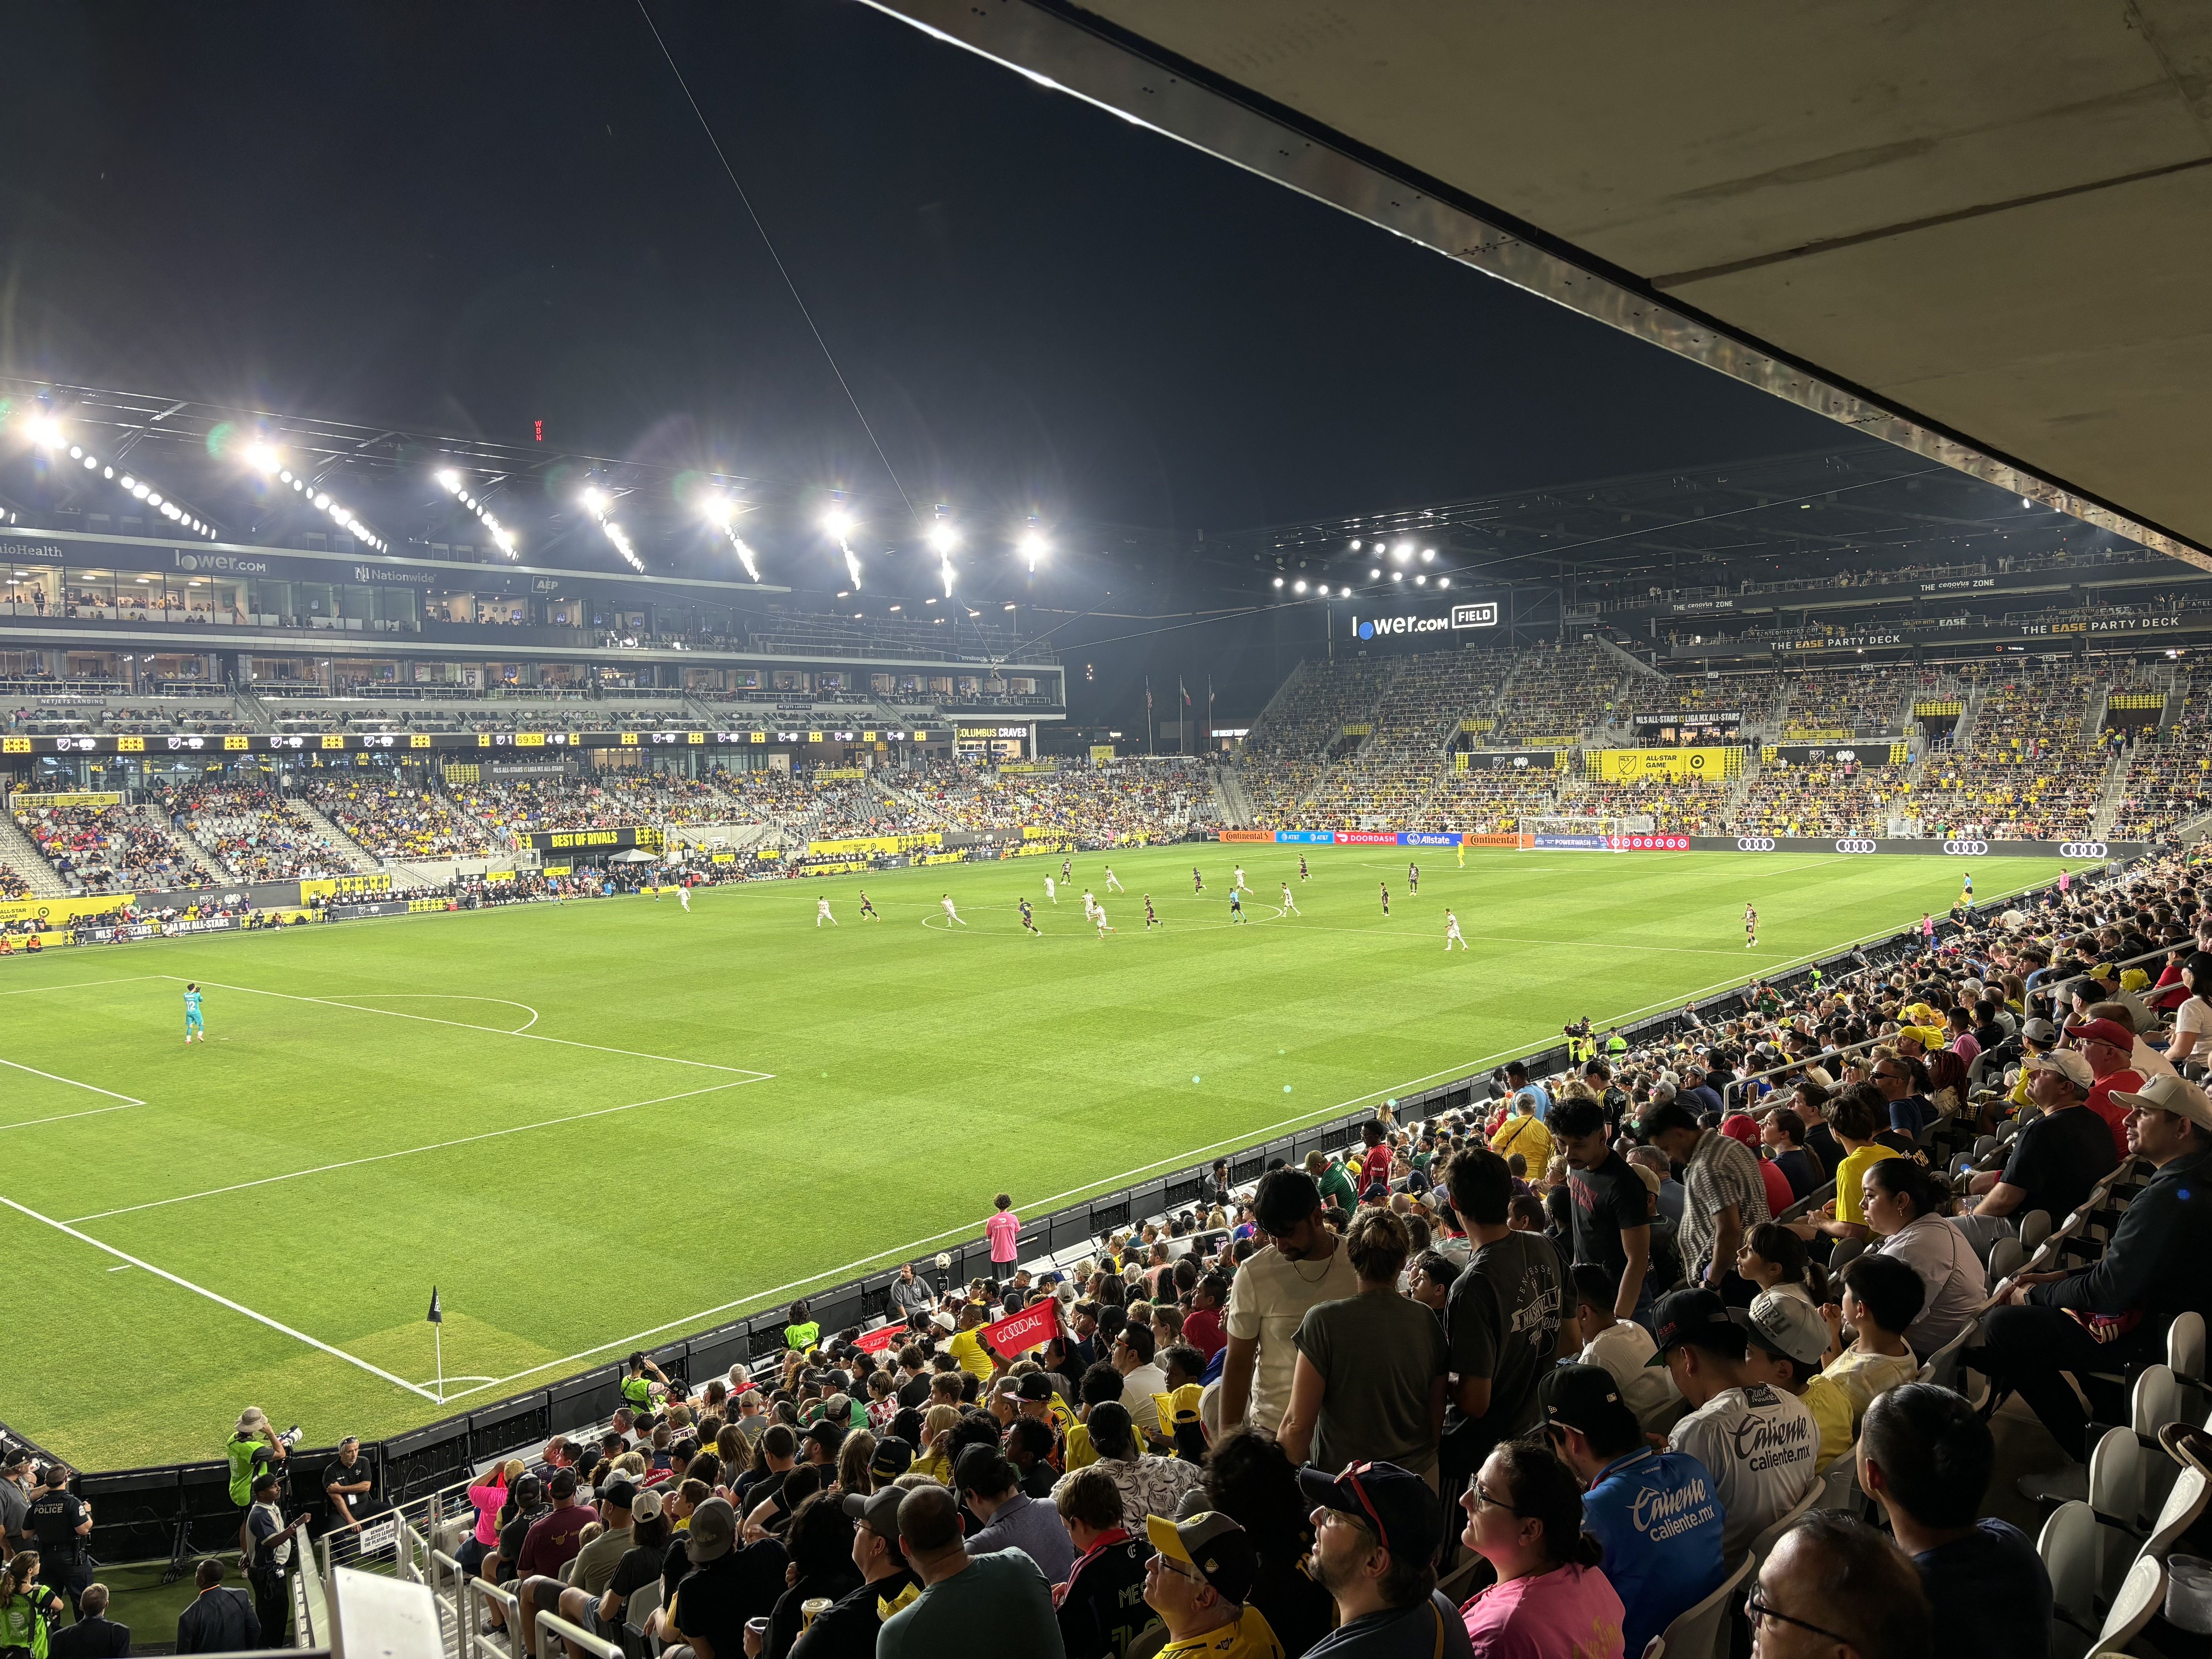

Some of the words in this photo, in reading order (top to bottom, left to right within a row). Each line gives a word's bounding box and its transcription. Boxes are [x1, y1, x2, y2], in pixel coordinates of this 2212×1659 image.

[372, 569, 434, 583] Nationwide
[537, 580, 558, 589] AEP
[1973, 579, 1994, 587] ZONE
[1458, 609, 1490, 622] FIELD
[1939, 618, 1967, 627] EASE
[2021, 626, 2047, 635] THE
[2052, 622, 2087, 633] EASE
[2091, 619, 2136, 630] PARTY
[2142, 617, 2179, 627] DECK
[1771, 642, 1792, 650] THE
[1795, 640, 1824, 649] EASE
[1827, 637, 1864, 647] PARTY
[1869, 635, 1900, 644] DECK
[1648, 715, 1678, 723] ALL-STARS
[1678, 715, 1685, 723] VS
[1685, 714, 1698, 722] LIGA
[1699, 714, 1708, 722] MX
[1709, 713, 1740, 721] ALL-STARS
[998, 728, 1027, 737] CRAVES
[507, 735, 512, 744] 1
[546, 735, 553, 744] 4
[551, 834, 574, 847] BEST
[575, 833, 586, 846] OF
[587, 831, 618, 845] RIVALS
[1226, 832, 1263, 841] Continental
[1420, 836, 1450, 844] Allstate
[1470, 835, 1517, 845] Continental
[96, 930, 112, 939] MLS
[153, 924, 160, 933] VS
[179, 921, 191, 931] MX
[192, 919, 229, 929] ALL-STARS
[1900, 1149, 1912, 1160] THE
[1727, 1413, 1807, 1460] Caliente
[1749, 1444, 1810, 1472] caliente.mx
[1626, 1478, 1706, 1532] Caliente
[1650, 1505, 1715, 1542] caliente.mx
[371, 1526, 385, 1535] BEWARE
[365, 1533, 381, 1542] OBJECTS
[372, 1535, 387, 1545] PLAYING
